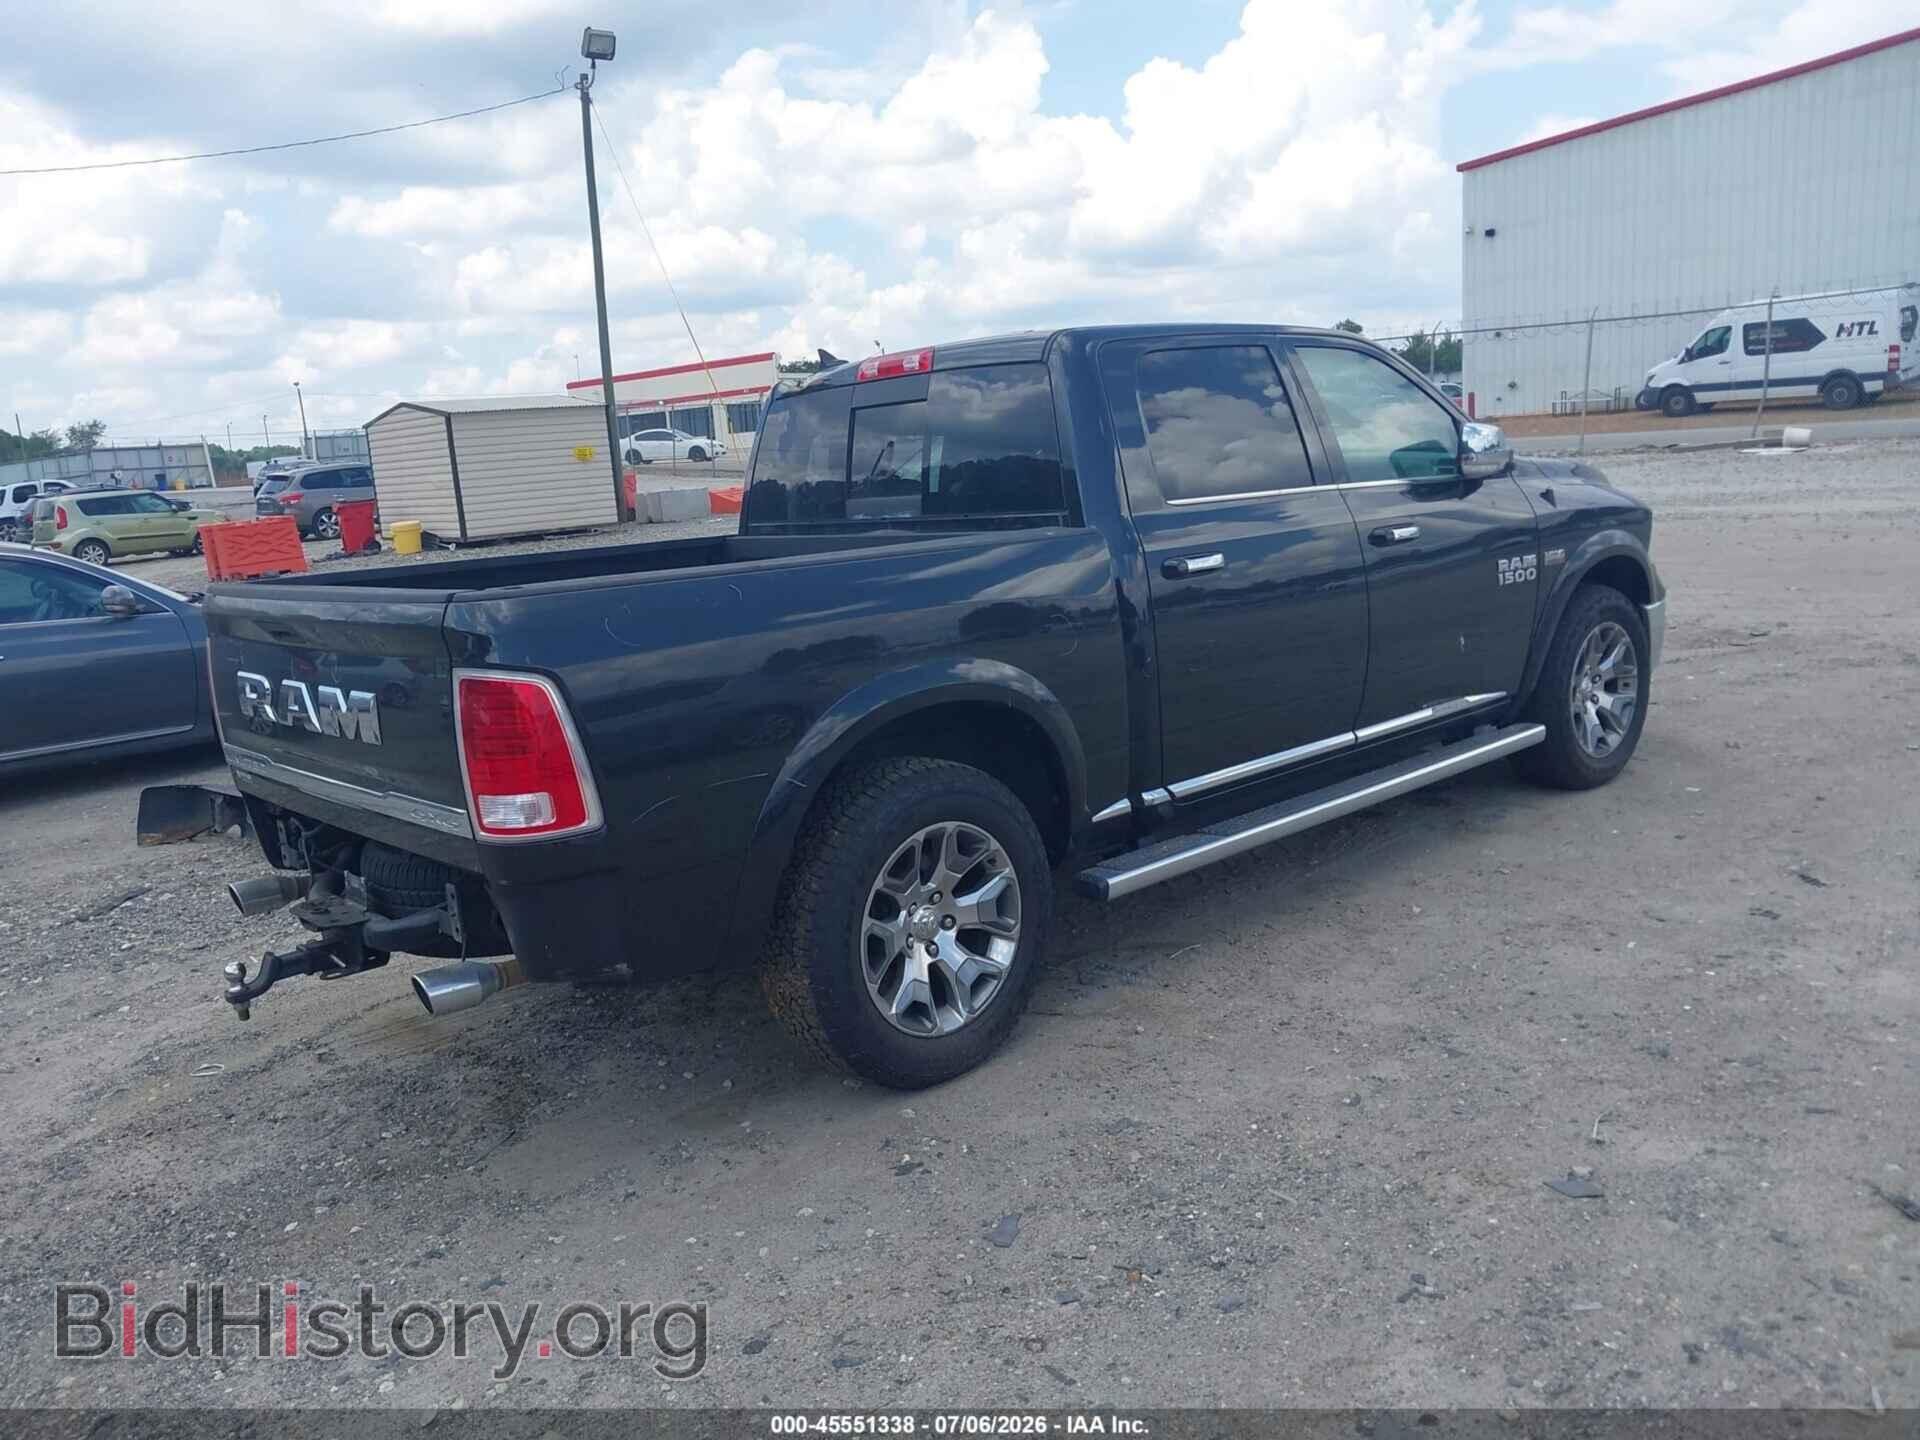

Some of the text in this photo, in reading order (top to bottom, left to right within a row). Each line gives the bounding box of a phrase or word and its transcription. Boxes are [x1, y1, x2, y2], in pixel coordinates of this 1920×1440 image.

[1498, 554, 1537, 573] RAM
[1498, 567, 1537, 586] 1500
[236, 670, 383, 746] RAM
